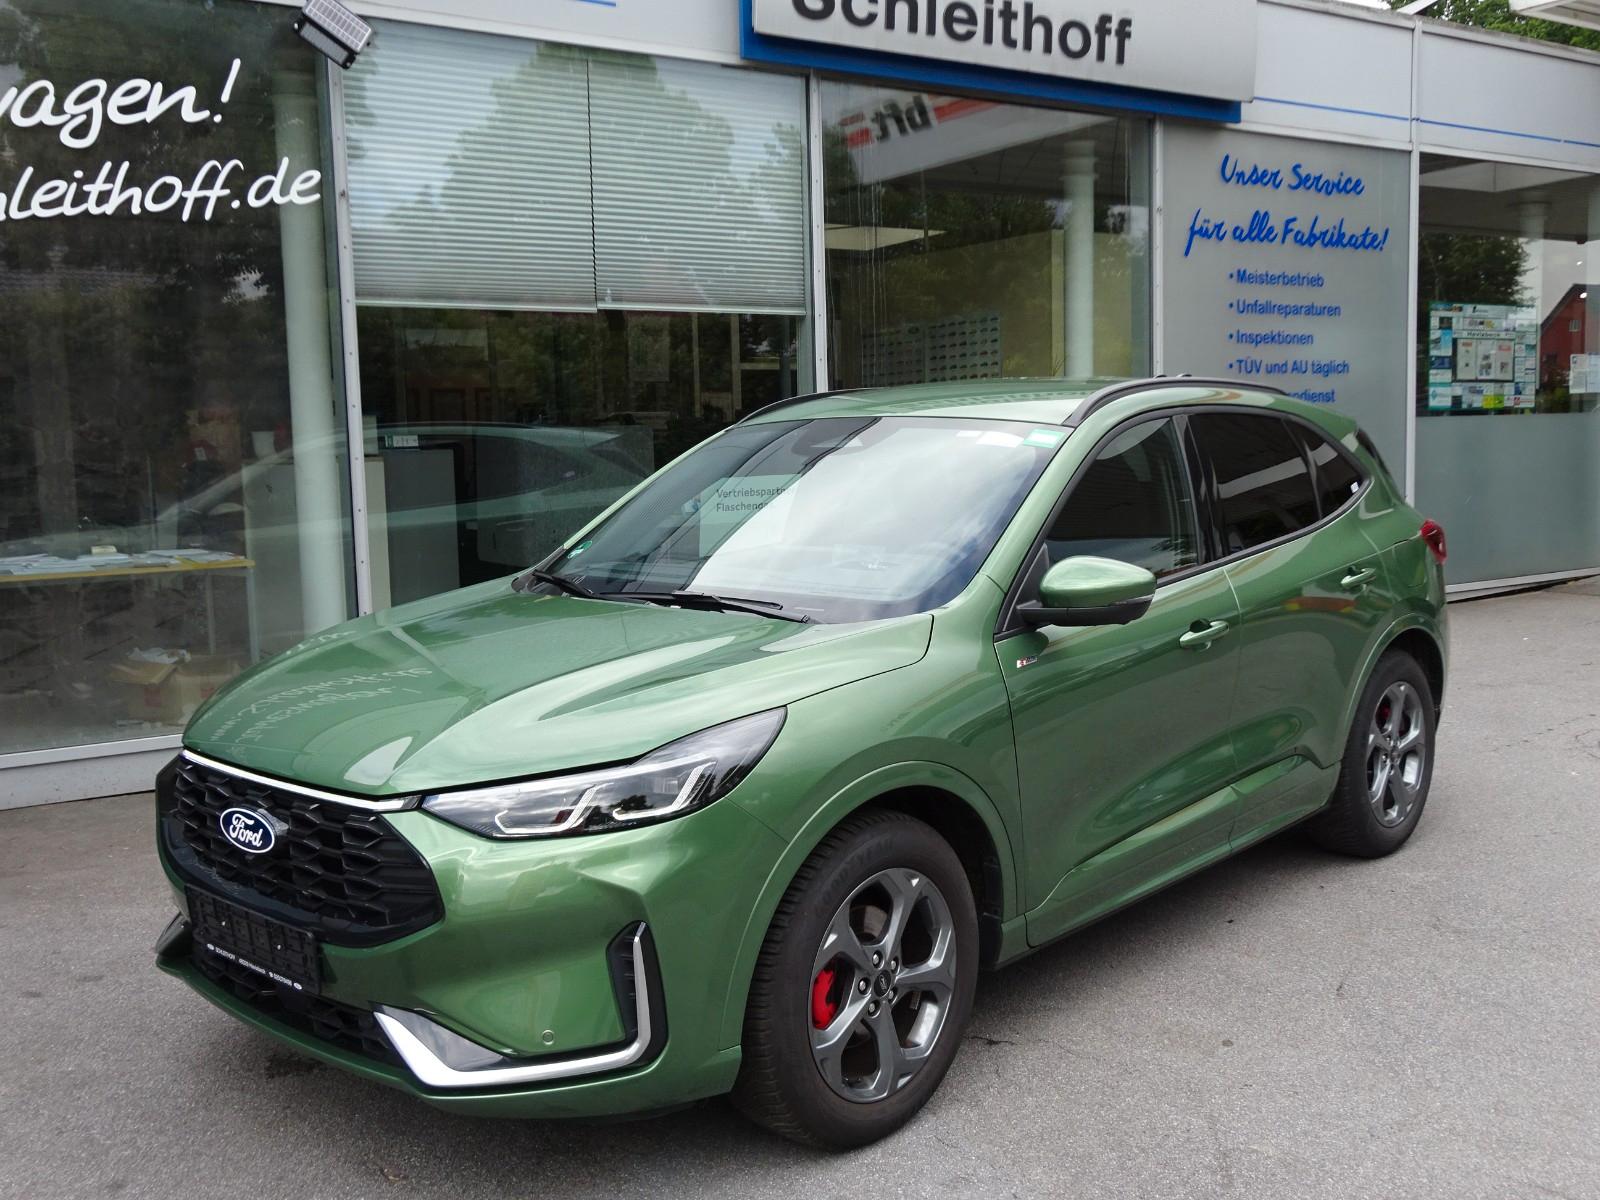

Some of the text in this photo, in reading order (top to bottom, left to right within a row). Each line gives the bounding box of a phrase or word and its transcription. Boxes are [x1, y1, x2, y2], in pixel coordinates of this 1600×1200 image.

[0, 58, 241, 149] agen!
[0, 157, 321, 222] leithoff.de
[1220, 153, 1365, 196] Unser Service
[1184, 207, 1390, 258] für alle Fabrikate!
[1236, 268, 1325, 288] Meisterbetrieb
[1236, 300, 1341, 318] Unfallreparaturen
[1236, 329, 1314, 347] Inspektionen
[1236, 356, 1350, 377] TÜV und AU täglich
[229, 813, 263, 848] Ford
